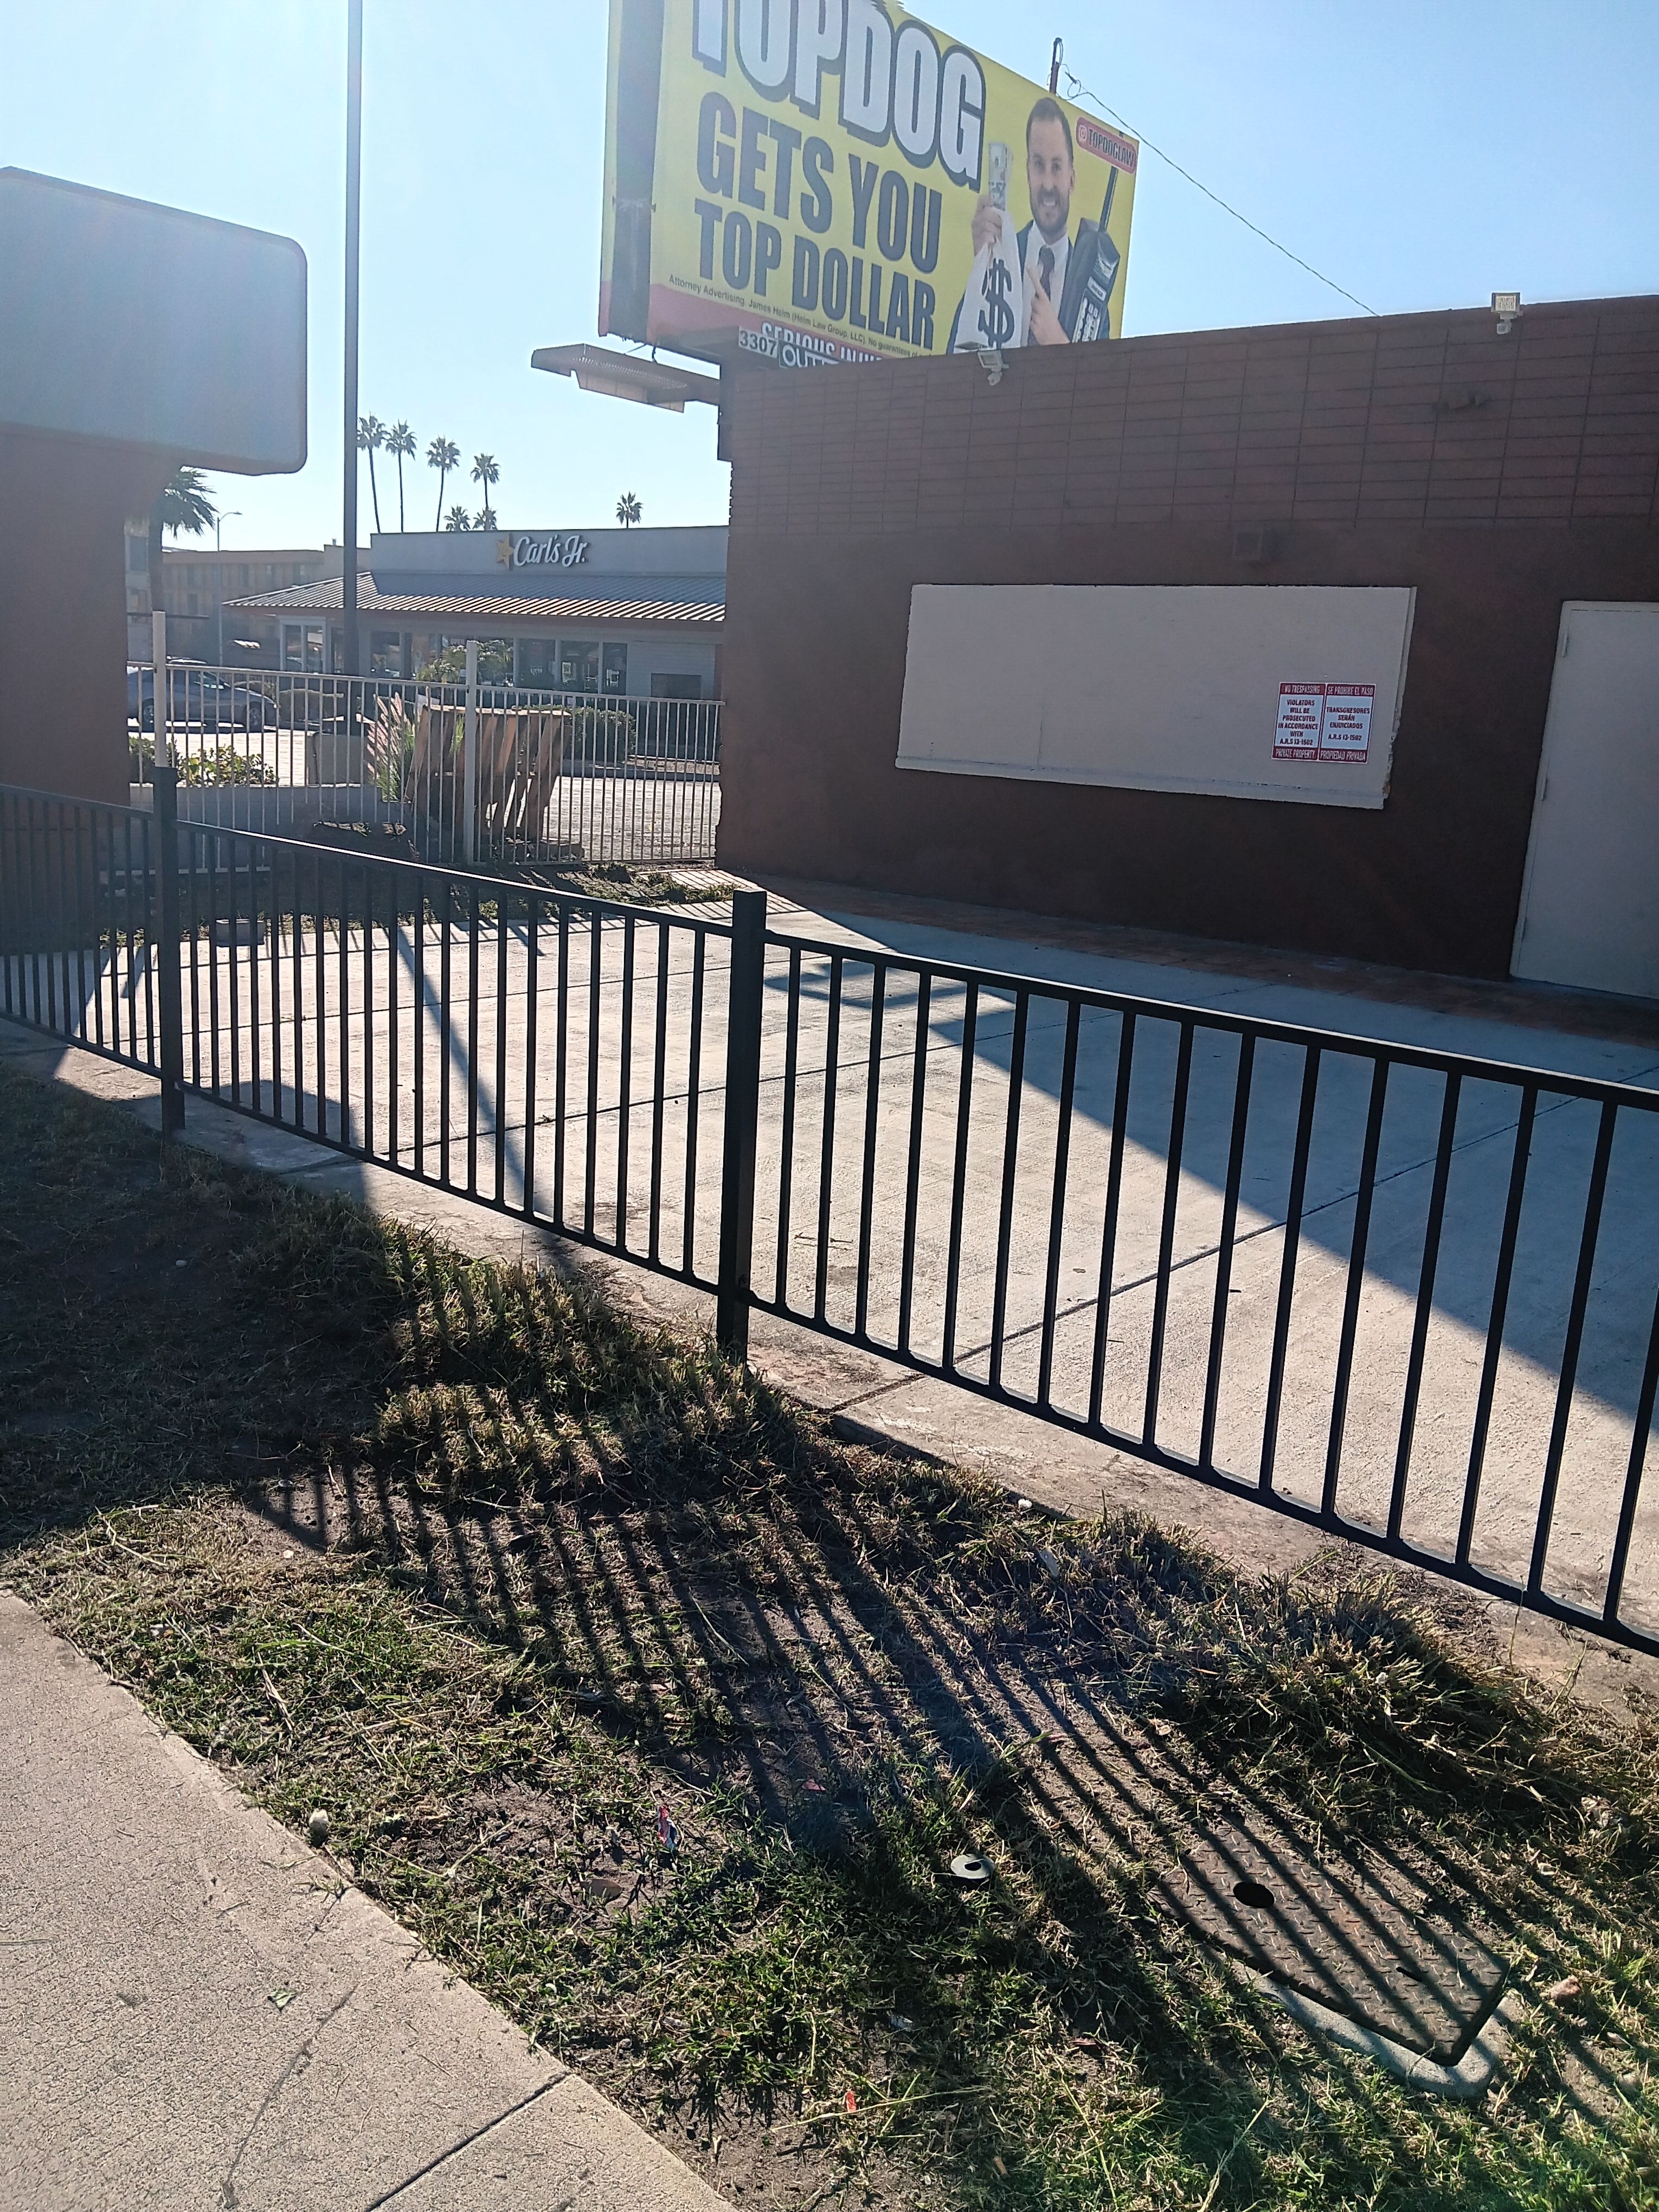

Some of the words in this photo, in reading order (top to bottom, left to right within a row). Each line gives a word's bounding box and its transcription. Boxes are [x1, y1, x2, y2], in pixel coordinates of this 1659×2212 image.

[1088, 129, 1134, 167] TOPDOGLAW
[697, 92, 834, 234] GETS
[848, 153, 942, 274] YOU
[695, 198, 782, 297] TOP
[792, 235, 936, 351] DOLLAR
[669, 274, 702, 294] Attorney
[749, 299, 771, 313] James
[813, 318, 826, 331] Law
[869, 337, 877, 347] No
[878, 341, 911, 357] guarantees
[740, 329, 777, 357] 3307
[514, 534, 561, 567] Carl's
[562, 535, 588, 567] Jr.
[1285, 685, 1290, 693] NO
[1292, 685, 1320, 693] TRESPASSING
[1328, 686, 1334, 694] SE
[1334, 686, 1354, 695] PROHIBE
[1355, 687, 1360, 695] EL
[1361, 687, 1373, 695] PASO
[1276, 748, 1293, 757] PRIVATE
[1293, 749, 1315, 758] PROPERTY
[1320, 750, 1345, 760] PROPIEDAD
[1346, 751, 1365, 761] PRIVADA
